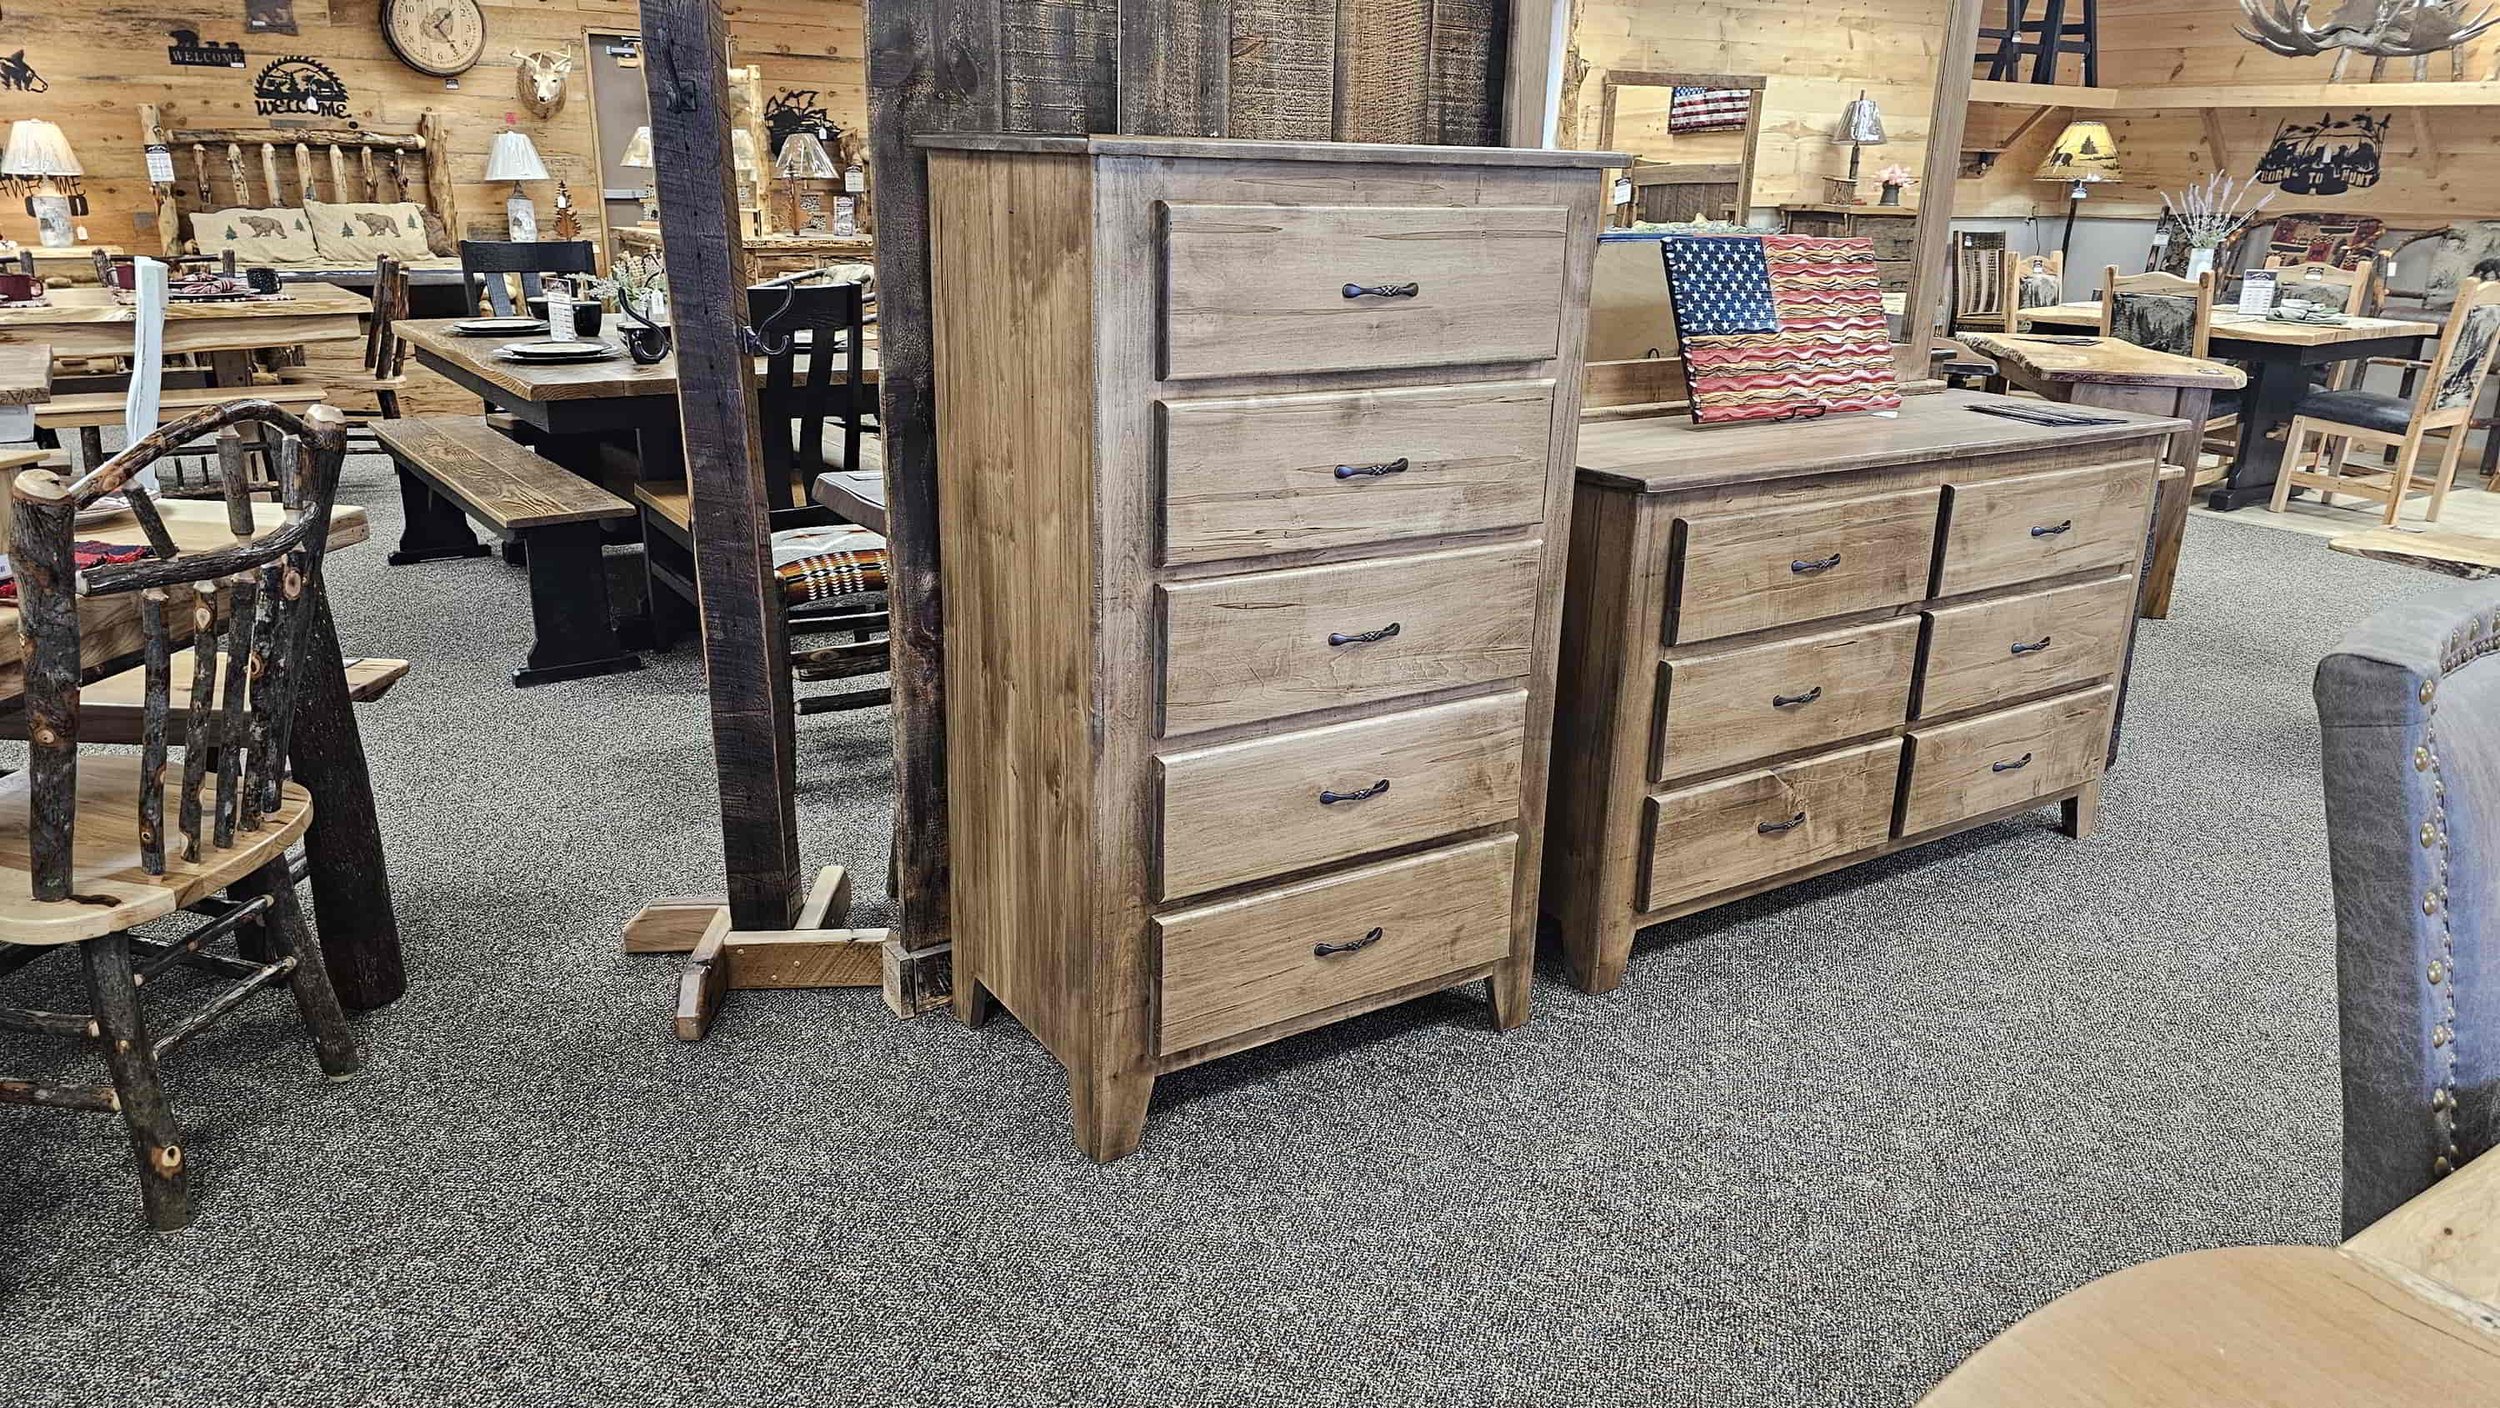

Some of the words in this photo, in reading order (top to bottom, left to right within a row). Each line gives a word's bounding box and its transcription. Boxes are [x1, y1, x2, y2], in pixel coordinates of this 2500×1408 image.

[405, 5, 414, 13] 10
[460, 8, 466, 17] 2
[403, 19, 408, 27] 9
[466, 25, 471, 33] 3
[463, 39, 468, 47] 4
[421, 47, 427, 55] 7
[172, 50, 240, 63] WELCOME
[437, 52, 443, 60] 6
[2260, 167, 2292, 182] BORN
[2308, 172, 2324, 184] TO
[2342, 169, 2373, 186] HUNT
